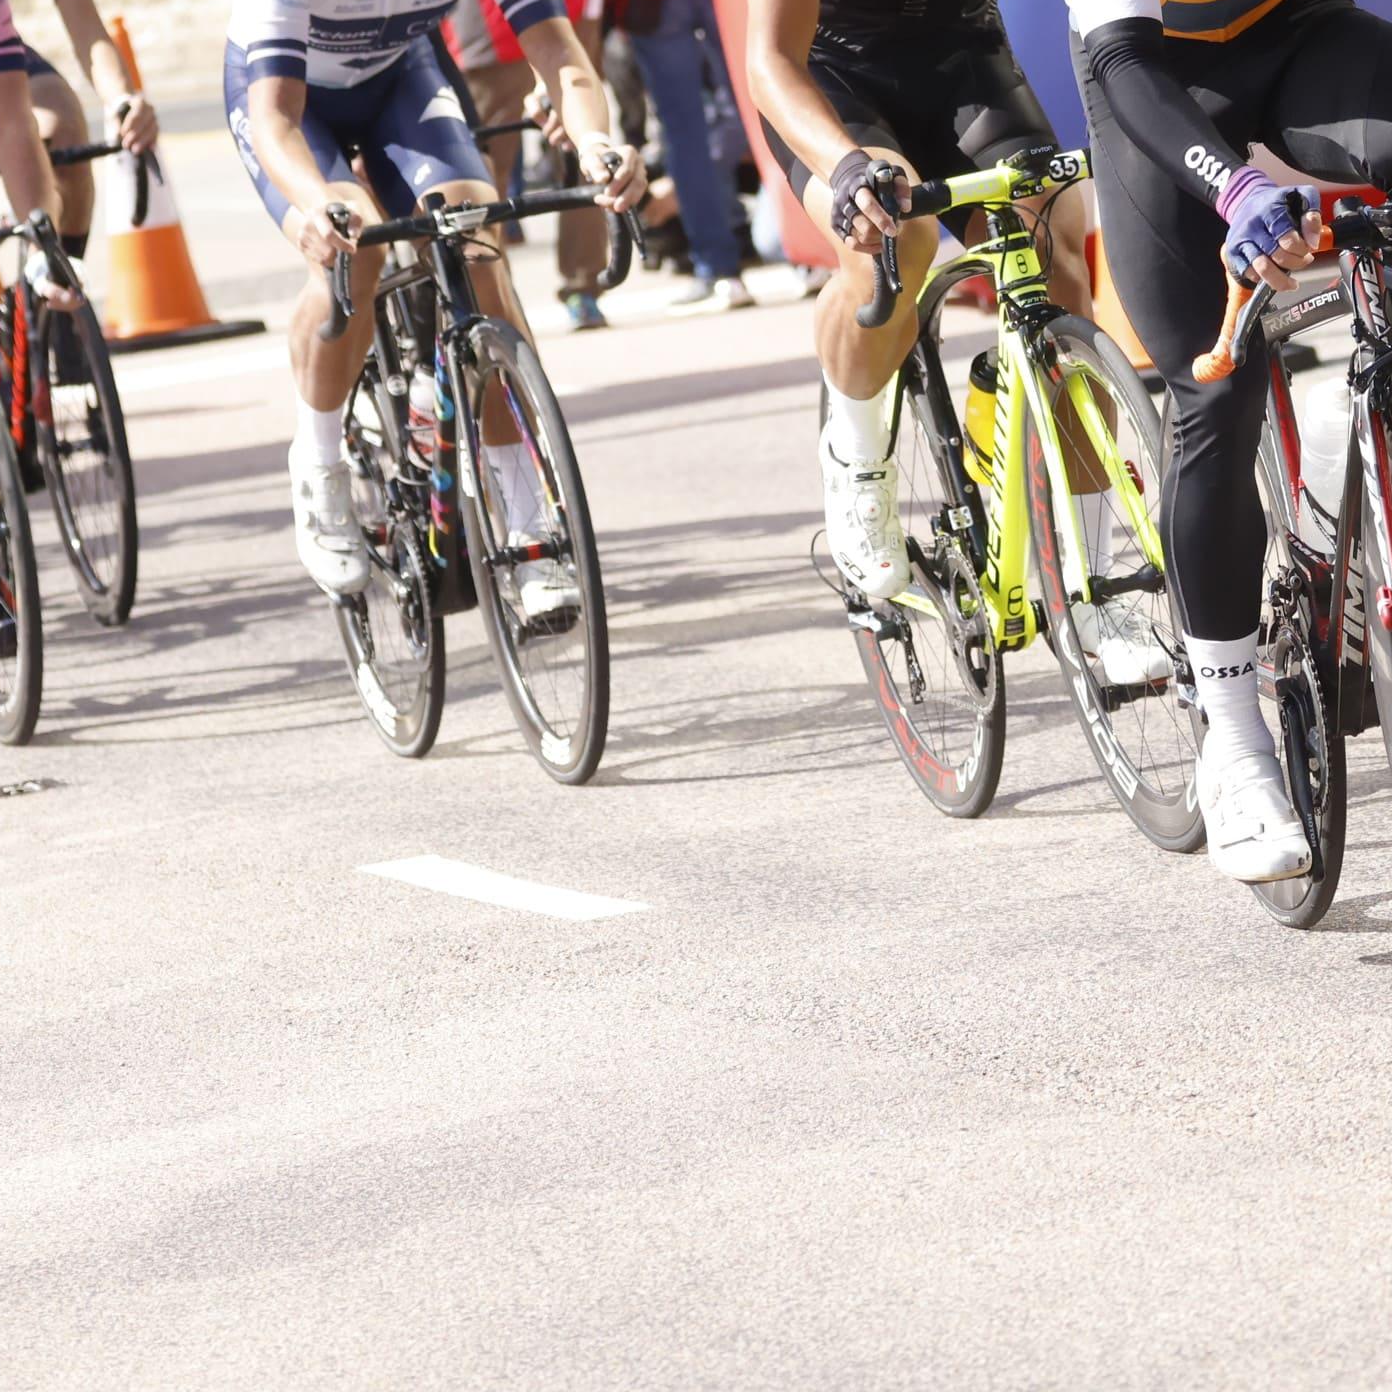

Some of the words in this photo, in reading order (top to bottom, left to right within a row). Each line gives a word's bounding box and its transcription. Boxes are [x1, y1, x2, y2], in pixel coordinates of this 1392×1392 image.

[1049, 158, 1078, 179] 35
[1185, 145, 1231, 193] OSSA
[1200, 661, 1255, 679] OSSA
